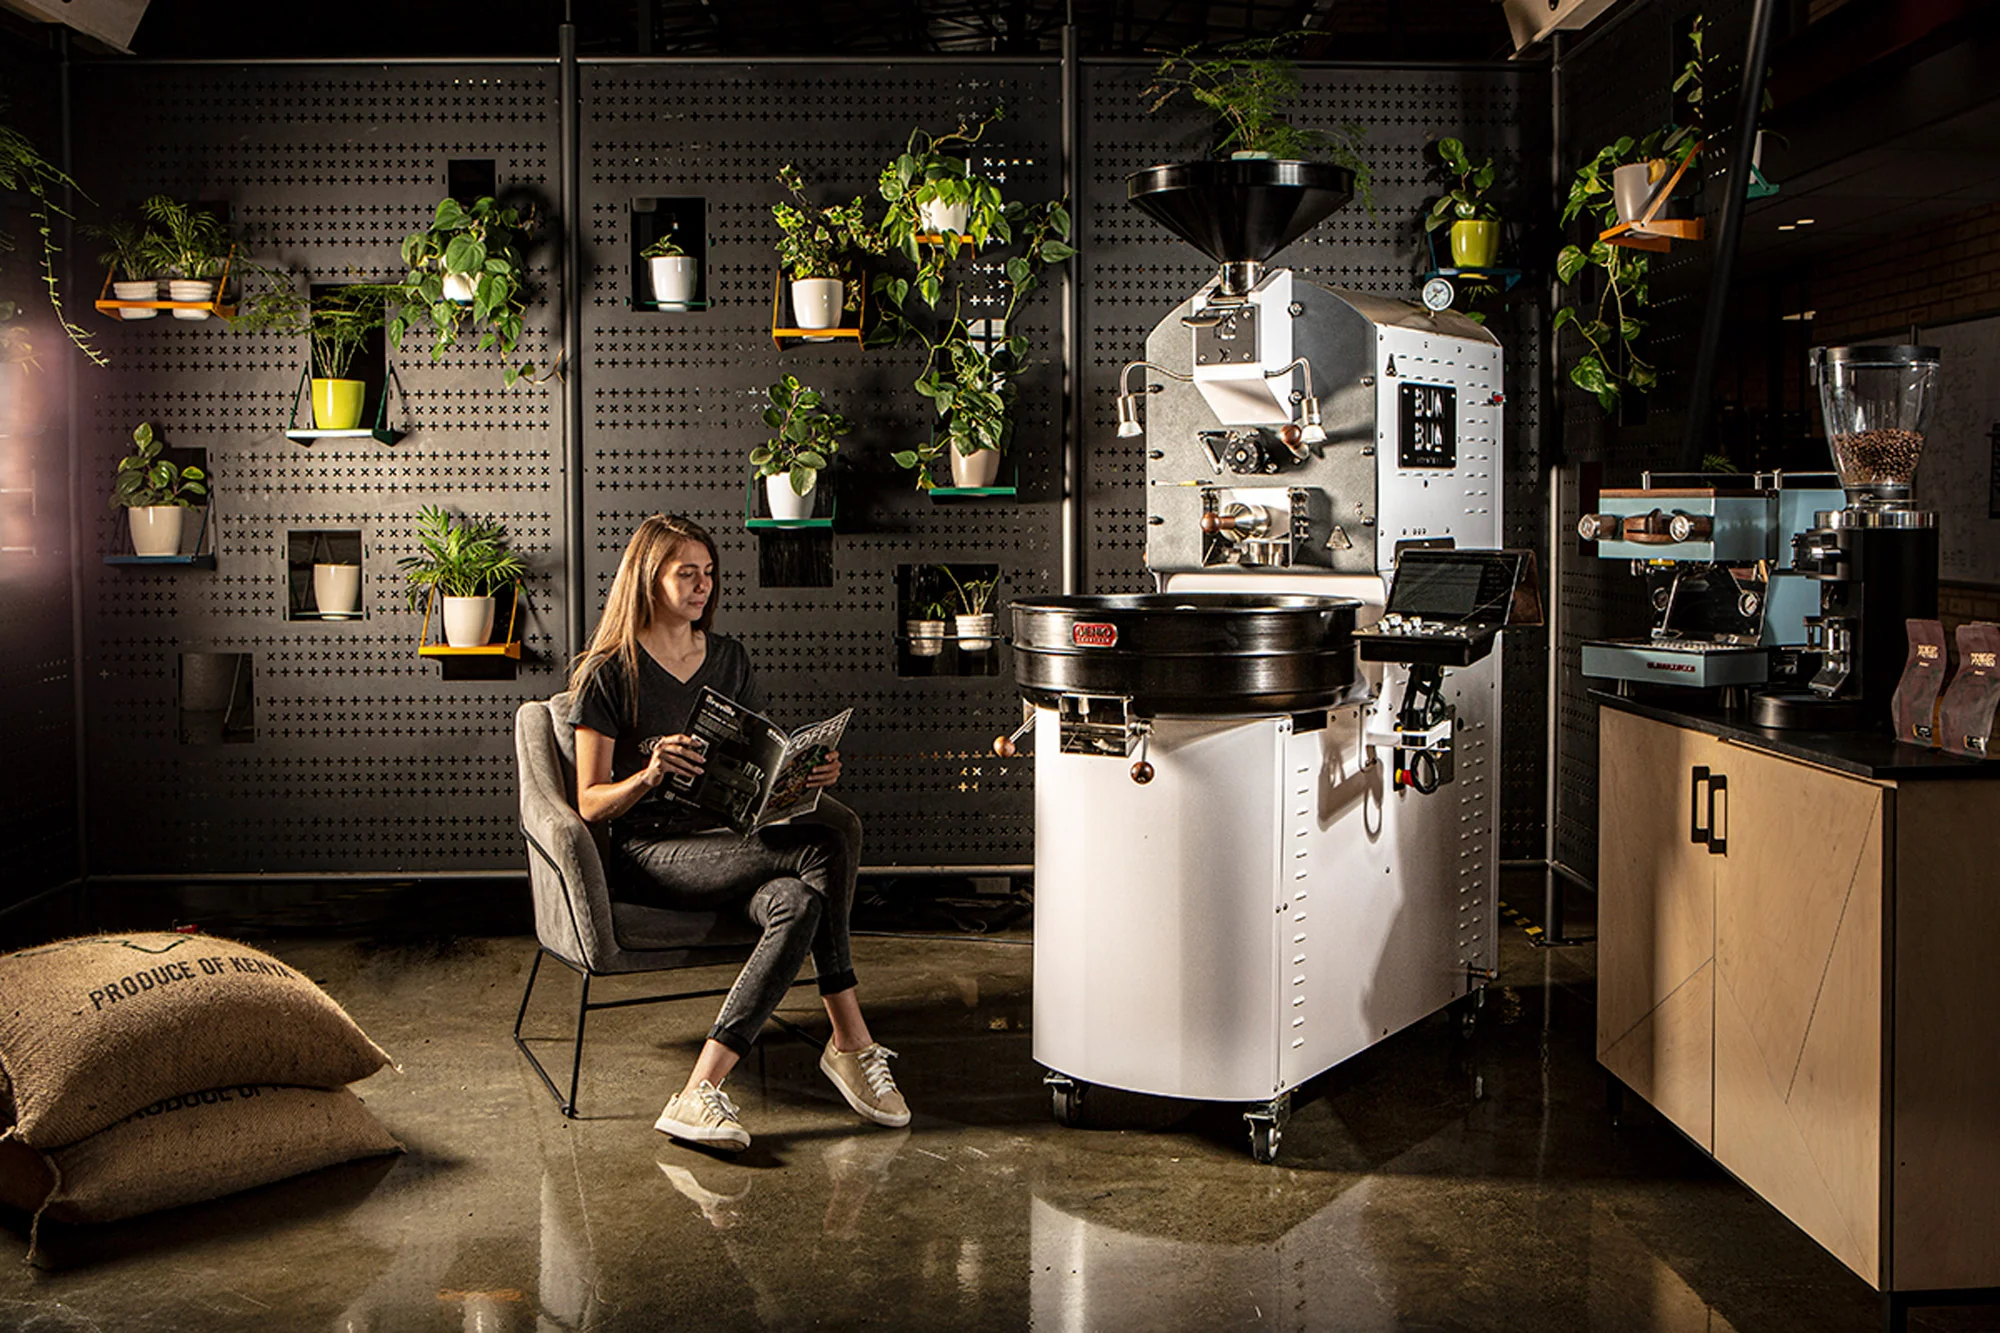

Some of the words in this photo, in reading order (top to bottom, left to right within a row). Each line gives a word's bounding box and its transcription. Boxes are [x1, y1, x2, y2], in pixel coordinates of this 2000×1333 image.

[89, 960, 196, 1011] PRODUCE
[198, 956, 225, 975] OF
[229, 956, 295, 979] KENYA
[124, 1086, 233, 1124] ODUCE
